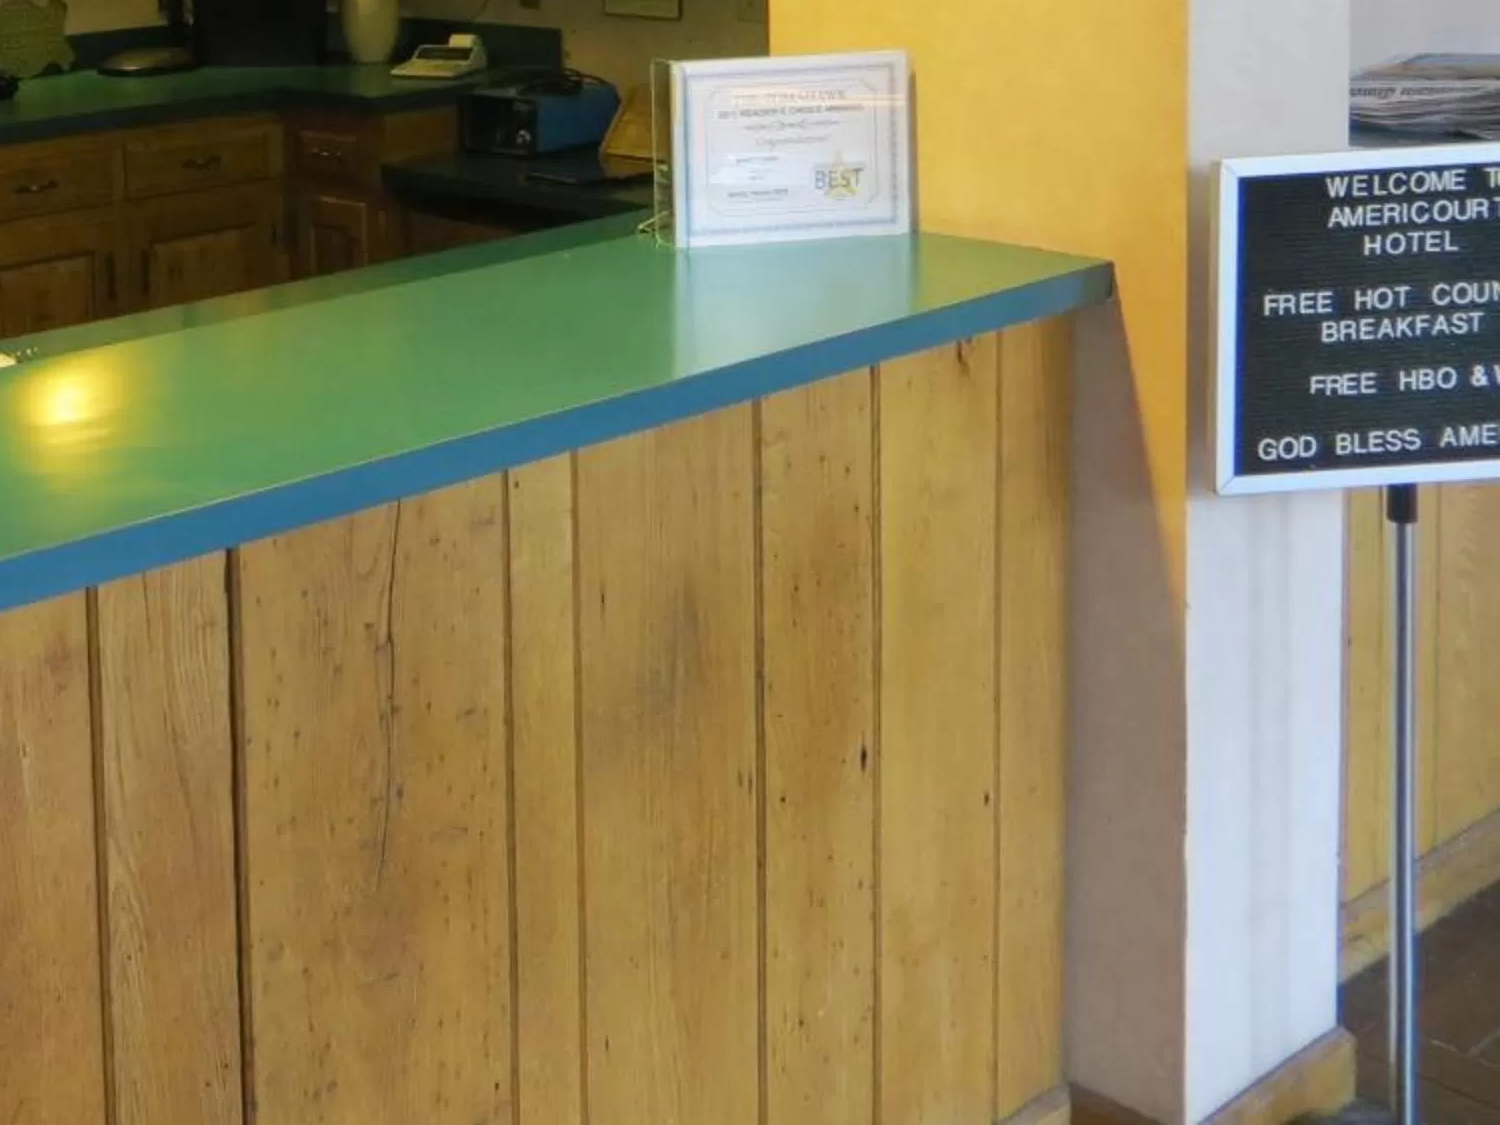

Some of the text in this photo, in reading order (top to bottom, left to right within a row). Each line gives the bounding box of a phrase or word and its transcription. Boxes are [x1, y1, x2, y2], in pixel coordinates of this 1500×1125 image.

[814, 166, 864, 190] BEST
[1325, 166, 1500, 199] WELCOME T
[1363, 230, 1460, 256] HOTEL
[1263, 291, 1334, 316] FREE
[1354, 286, 1411, 311] HOT
[1320, 312, 1485, 343] BREAKFAST
[1309, 372, 1378, 396] FREE
[1399, 366, 1457, 392] HBO
[1257, 435, 1317, 461] GOD
[1335, 428, 1421, 456] BLESS
